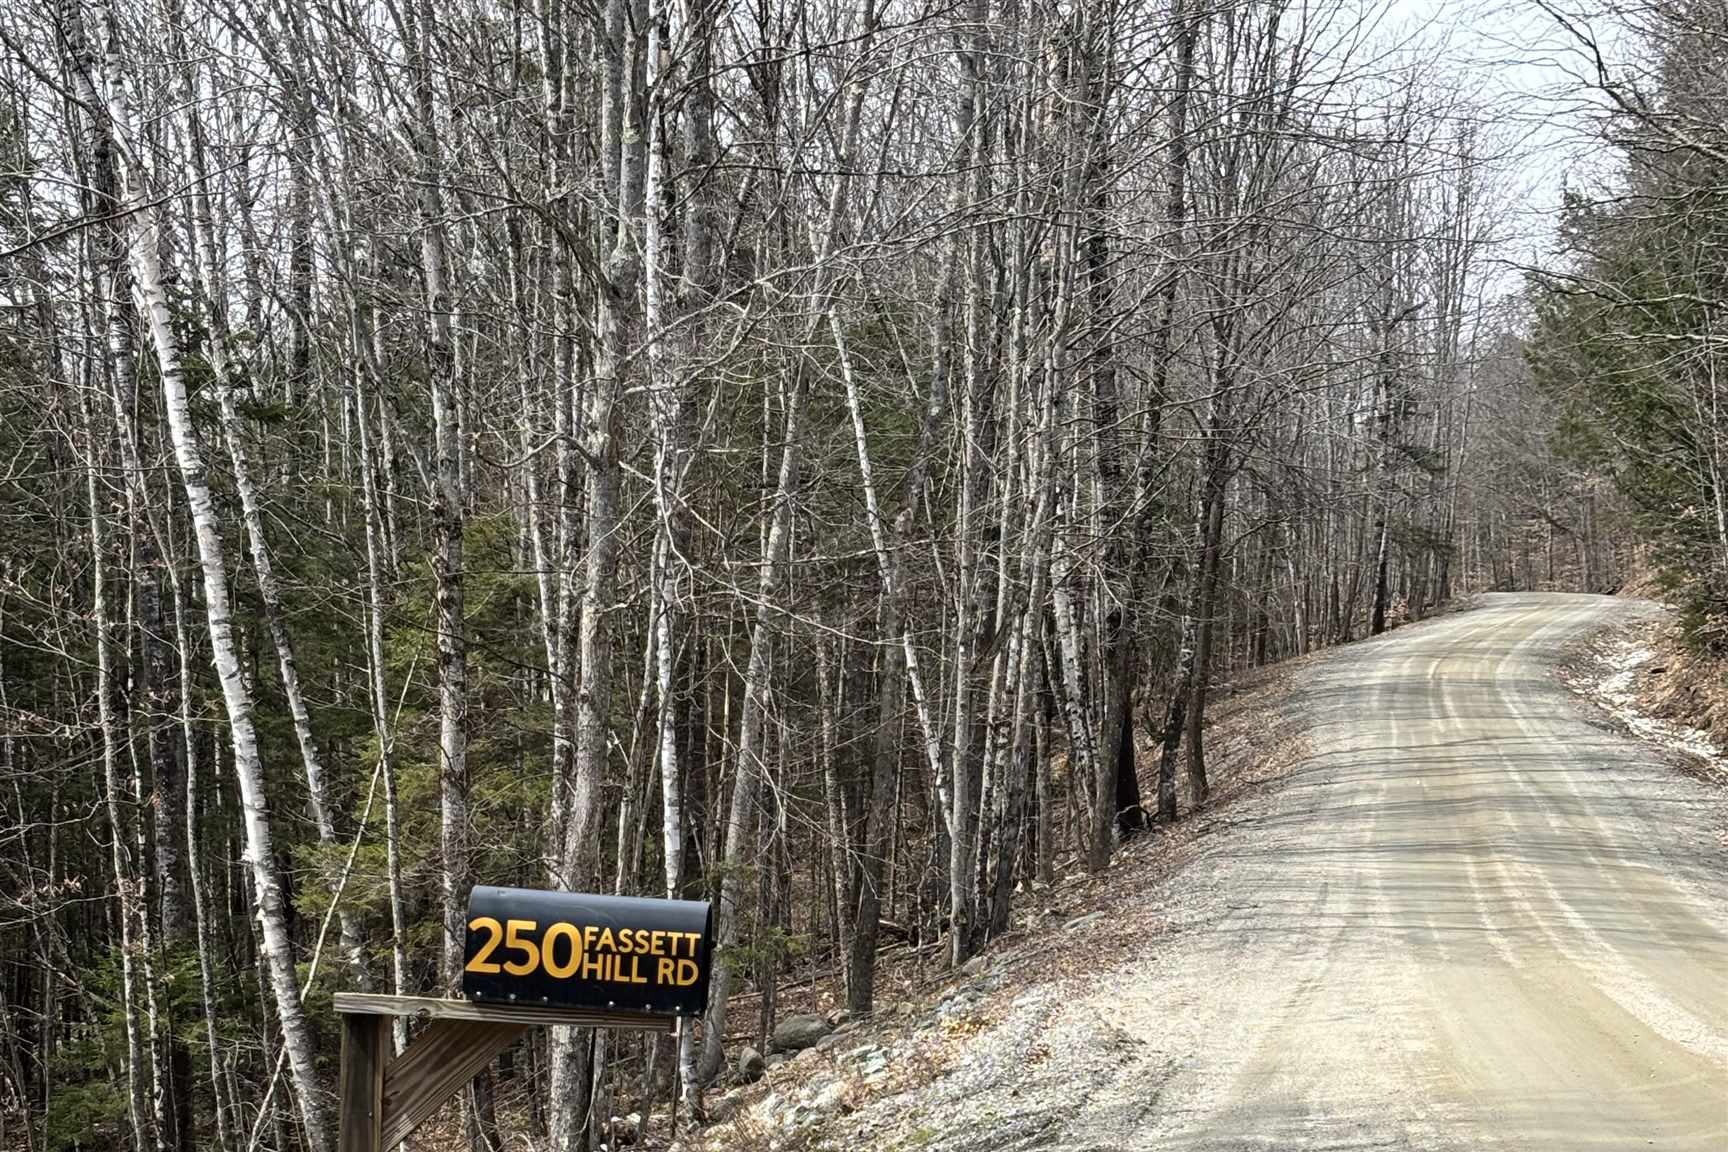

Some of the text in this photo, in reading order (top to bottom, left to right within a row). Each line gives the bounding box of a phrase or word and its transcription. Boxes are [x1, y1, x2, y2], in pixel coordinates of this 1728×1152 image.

[465, 916, 583, 979] 250
[583, 926, 701, 957] FASSETT
[582, 952, 699, 986] HILL RD
